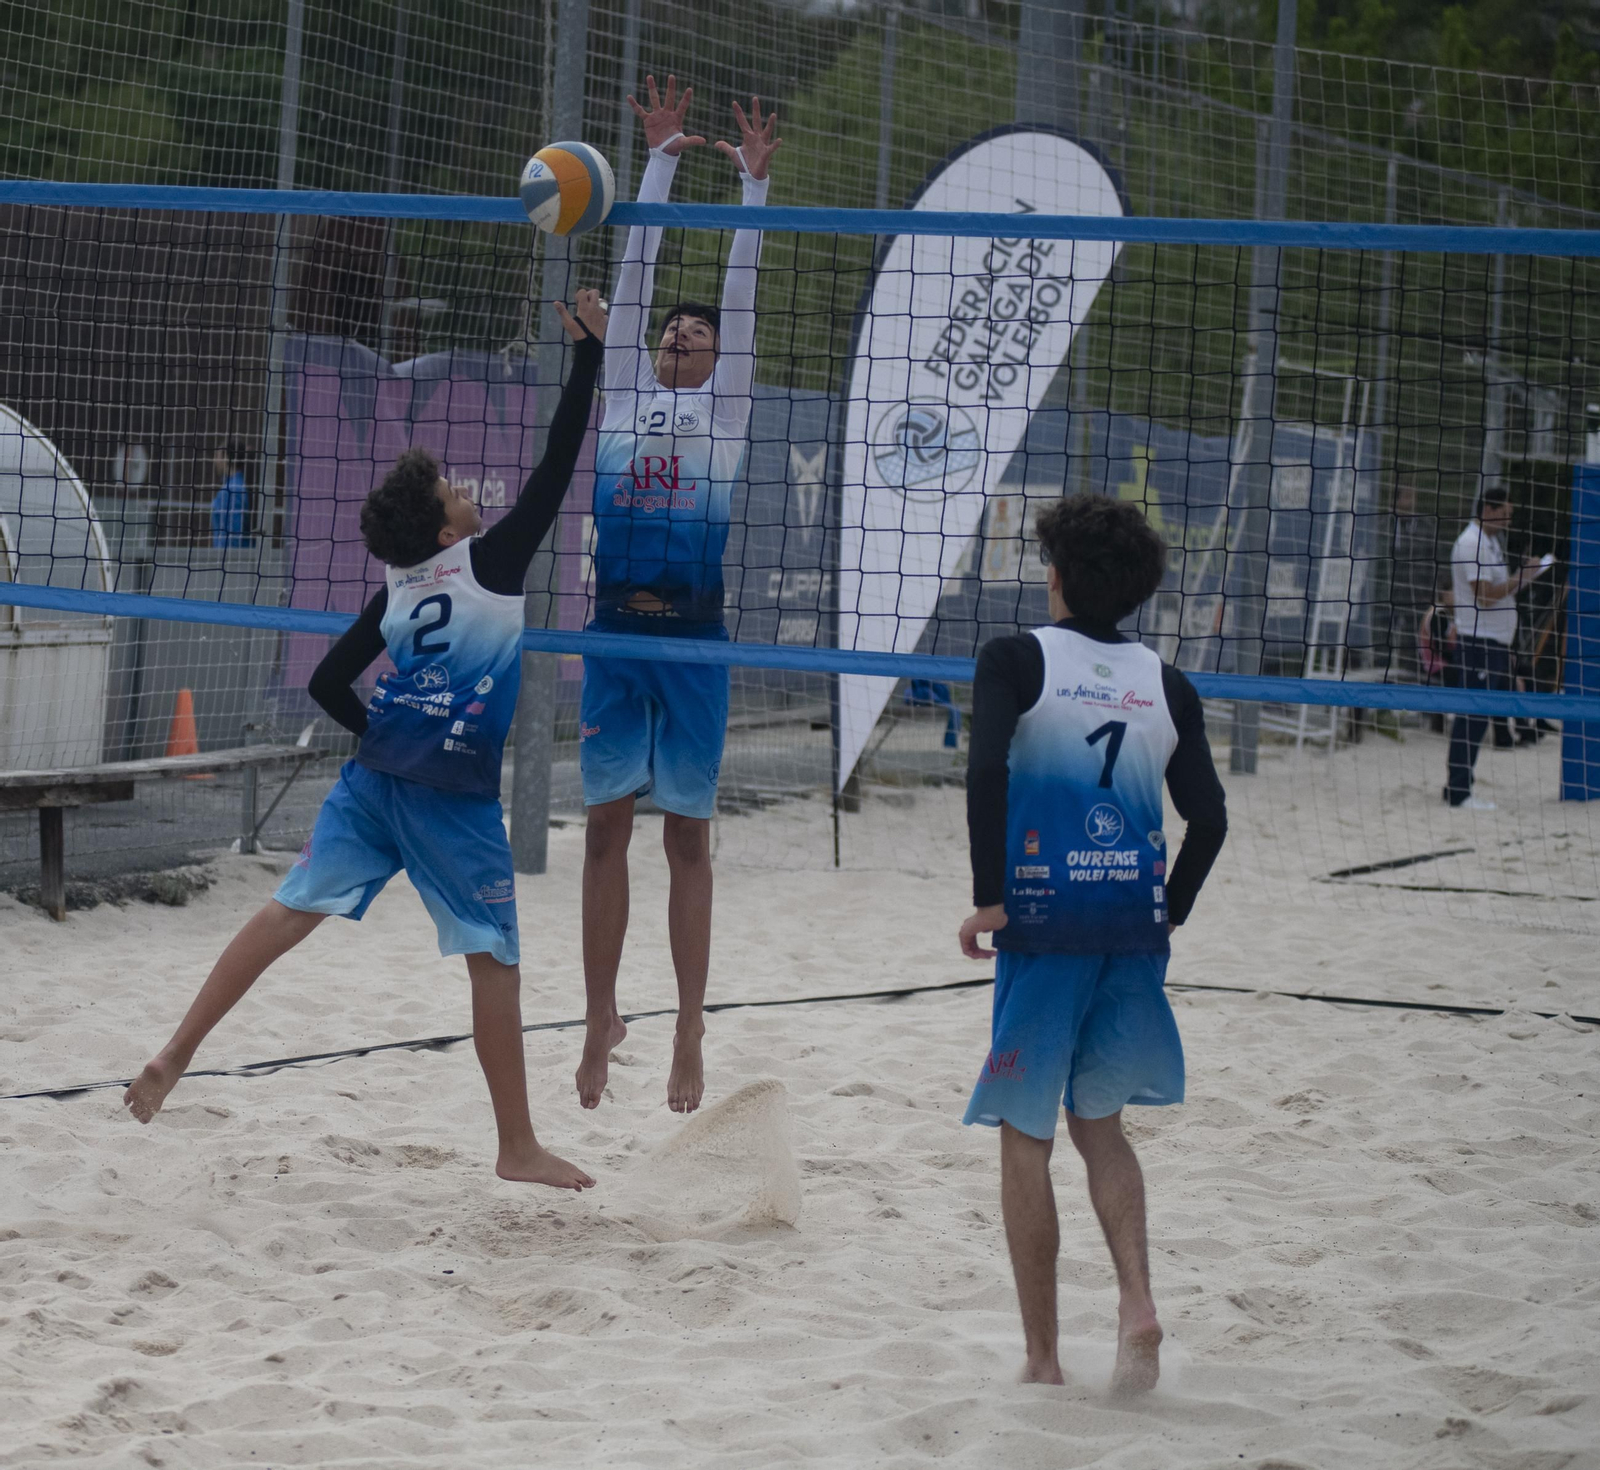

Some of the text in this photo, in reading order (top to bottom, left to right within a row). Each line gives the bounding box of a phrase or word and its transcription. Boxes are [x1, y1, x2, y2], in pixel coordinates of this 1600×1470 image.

[529, 163, 544, 179] P2
[954, 240, 1055, 390] GALEGA DE
[979, 273, 1073, 401] VOLEIBOL
[648, 411, 666, 437] 2
[614, 455, 696, 491] ARL
[613, 490, 695, 513] abogados
[409, 593, 453, 656] 2
[421, 703, 450, 718] PRAIA
[1085, 721, 1127, 789] 1
[1066, 850, 1140, 867] OURENSE
[1069, 869, 1140, 881] VOLEI PRAIA
